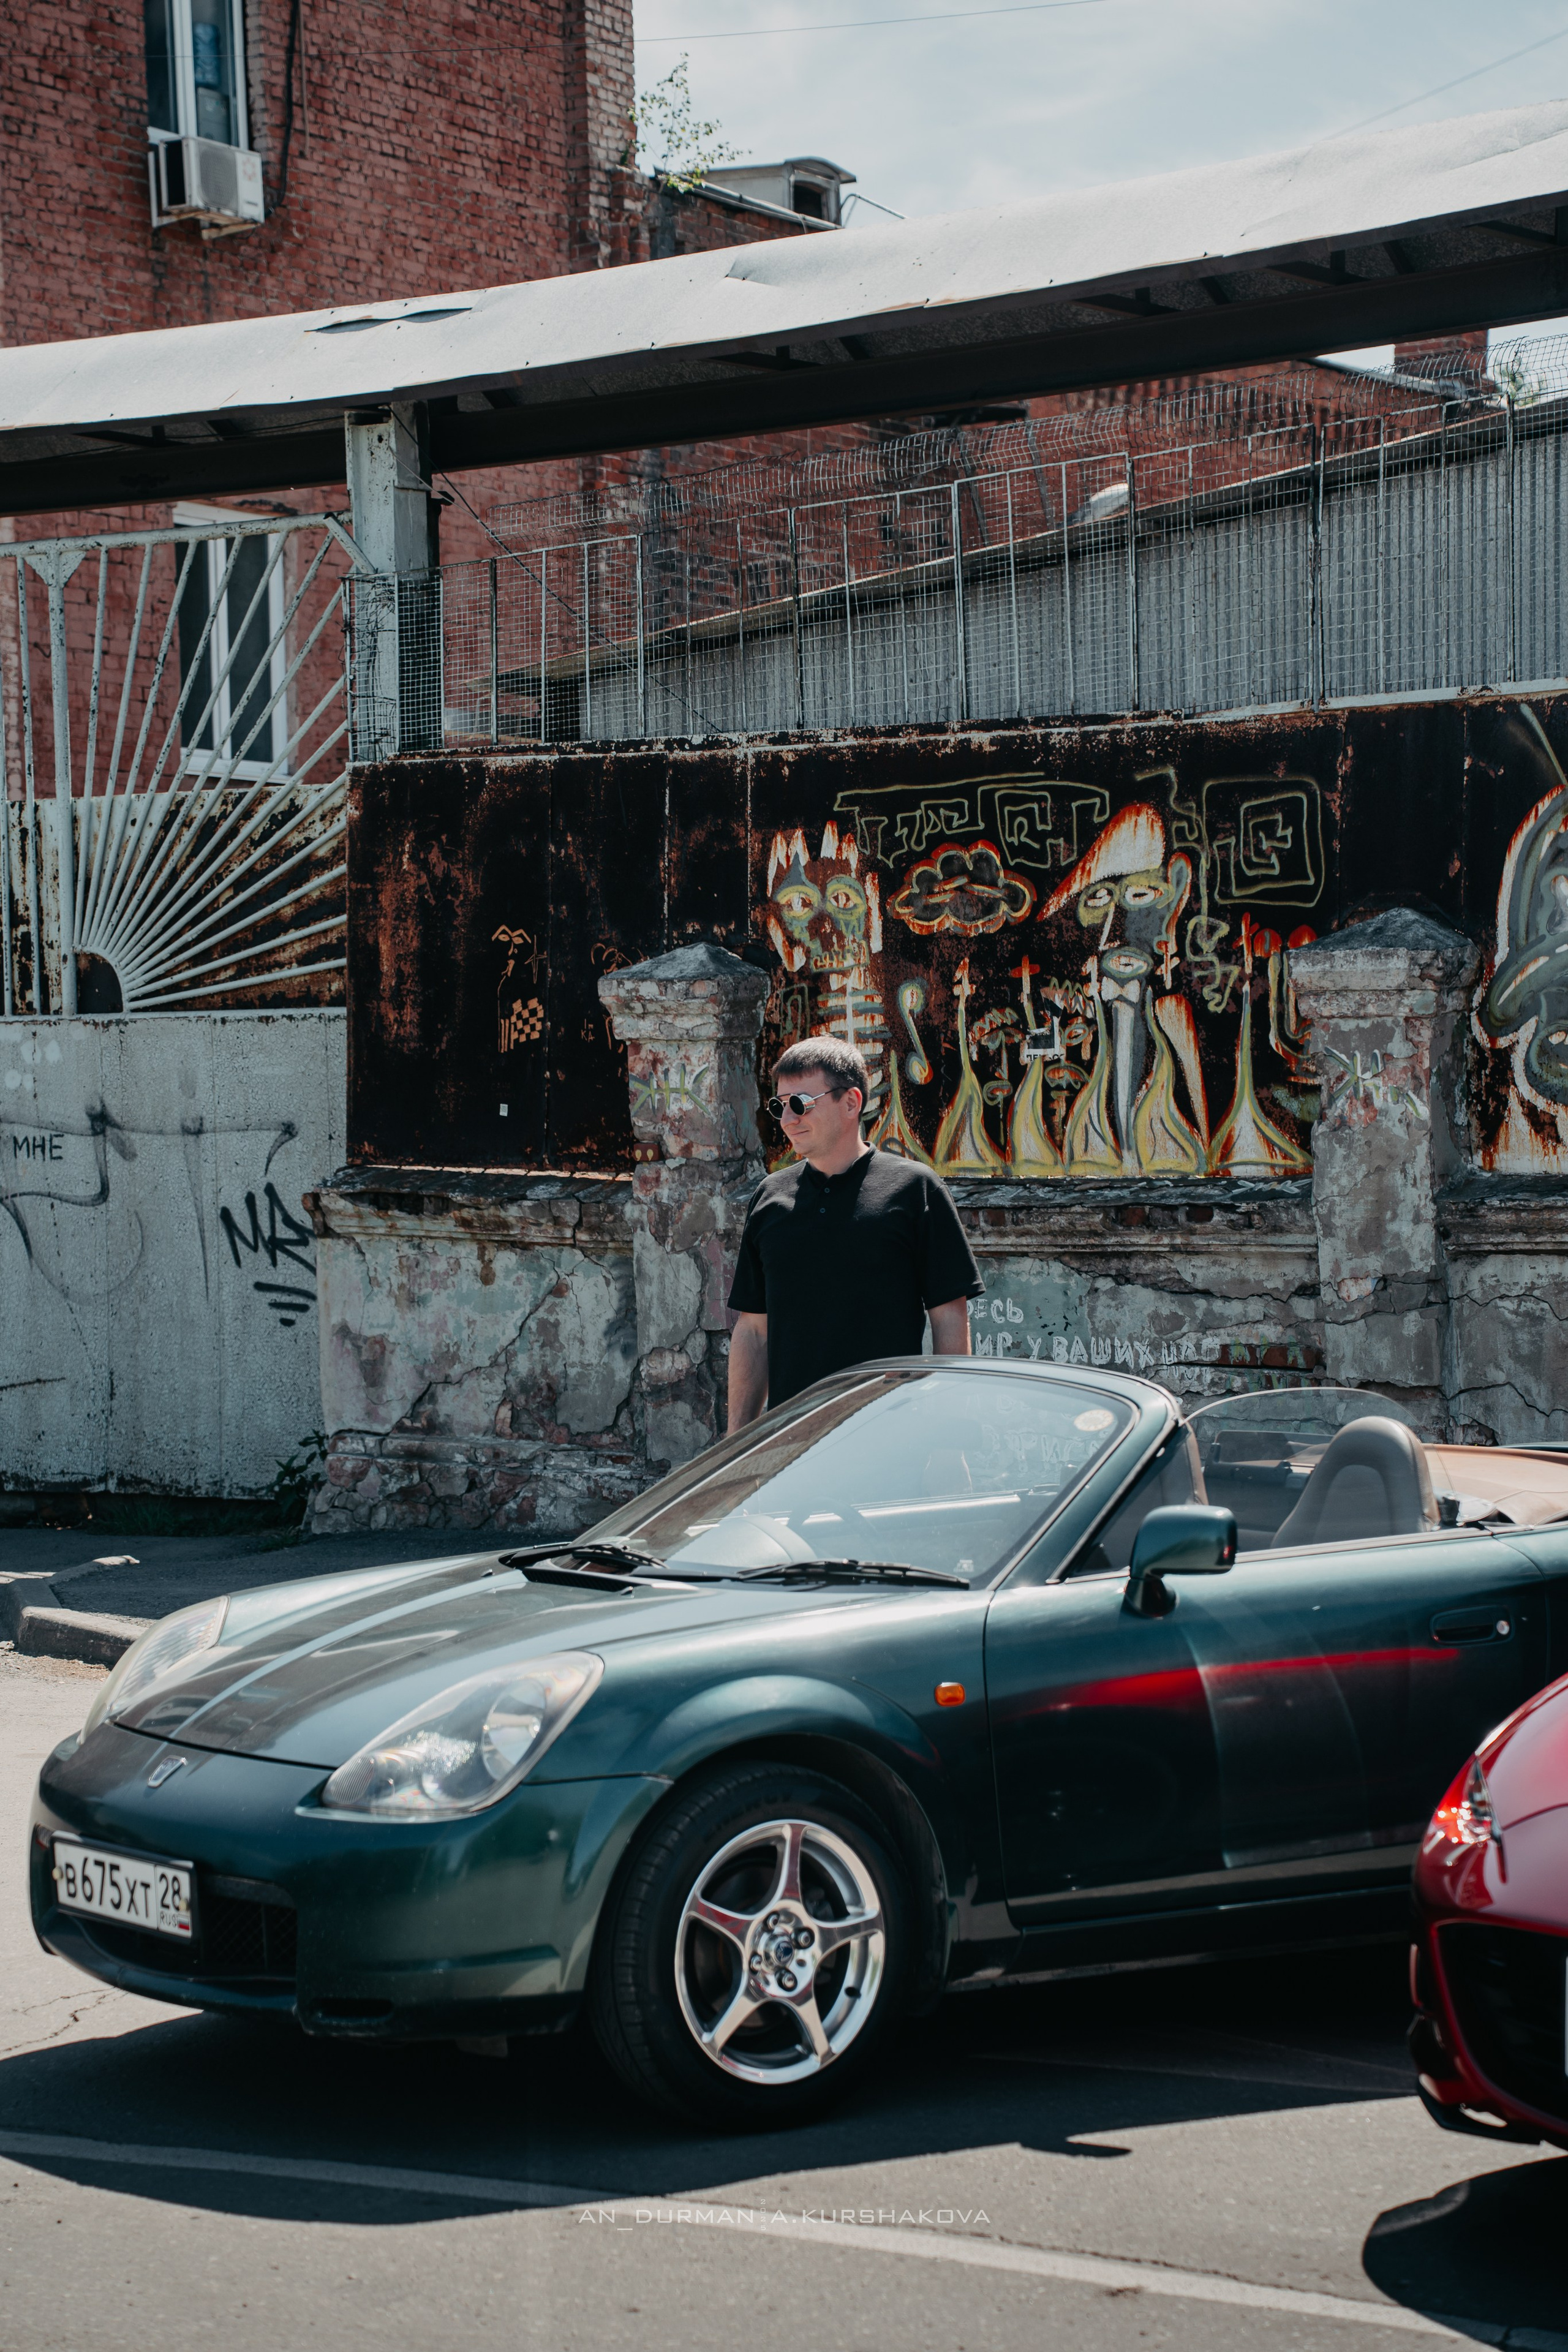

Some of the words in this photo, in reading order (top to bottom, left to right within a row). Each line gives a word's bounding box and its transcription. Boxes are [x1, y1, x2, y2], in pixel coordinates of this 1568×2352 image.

[1052, 1335, 1155, 1370] ВАШИХ
[66, 1857, 151, 1918] В675ХТ
[159, 1873, 181, 1911] 28
[160, 1912, 177, 1928] RUS
